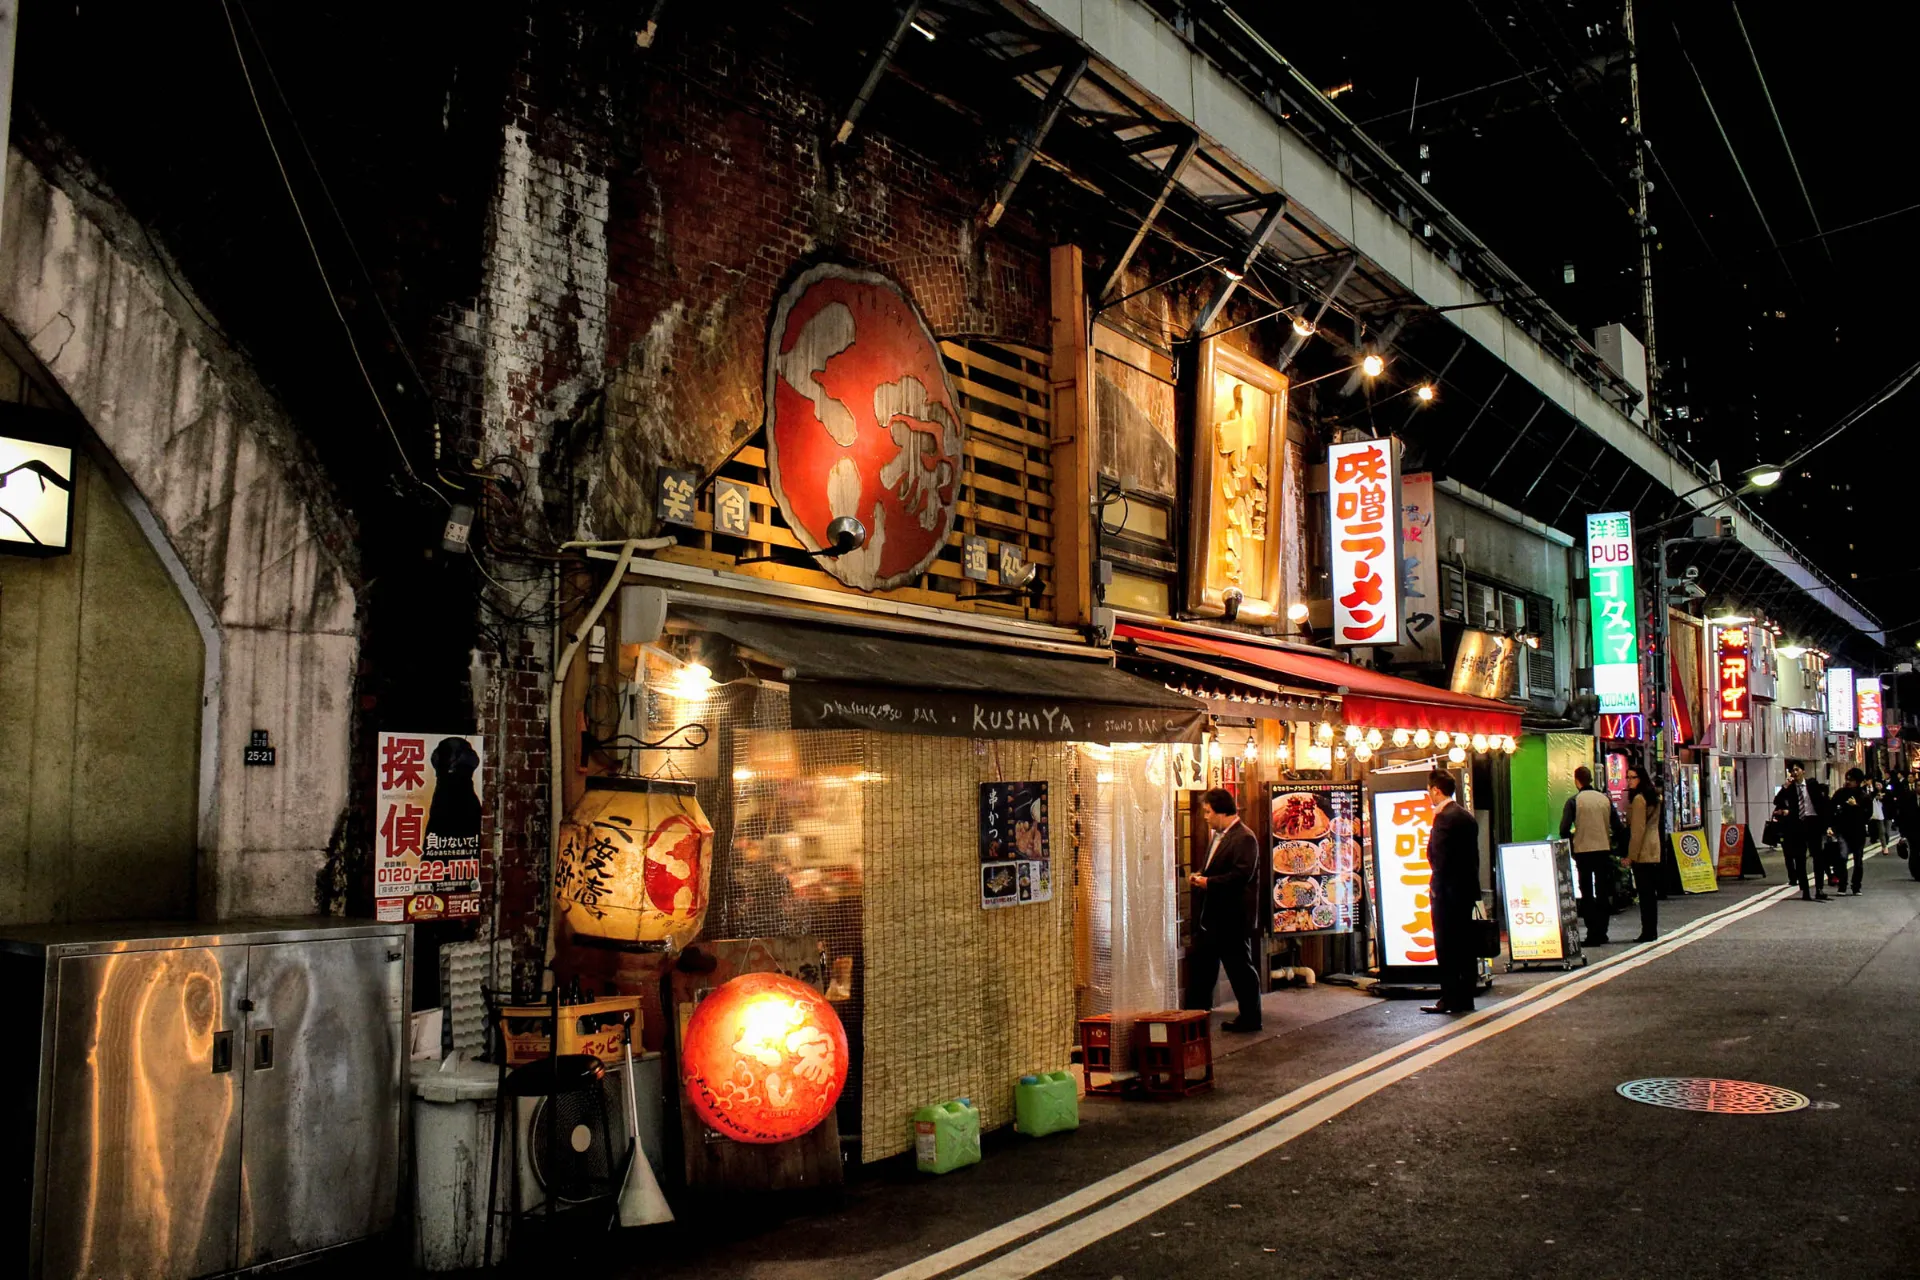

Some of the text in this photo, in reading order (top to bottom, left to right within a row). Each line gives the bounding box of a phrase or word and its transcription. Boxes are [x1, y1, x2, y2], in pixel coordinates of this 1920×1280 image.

[1590, 518, 1630, 539] 洋酒
[1334, 445, 1387, 640] 味噌ラーメン
[1592, 543, 1629, 563] PUB
[913, 707, 938, 723] BAR
[972, 704, 1075, 733] KUSHIYA
[1138, 719, 1158, 733] BAR
[248, 751, 272, 761] 25-21
[380, 737, 425, 858] 探偵
[988, 788, 999, 839] 串かつ
[426, 832, 479, 849] 負けないで!
[378, 860, 479, 882] 0120-22-1111
[461, 899, 479, 913] AG
[1515, 912, 1545, 925] 350
[582, 1034, 627, 1055] ホッピ
